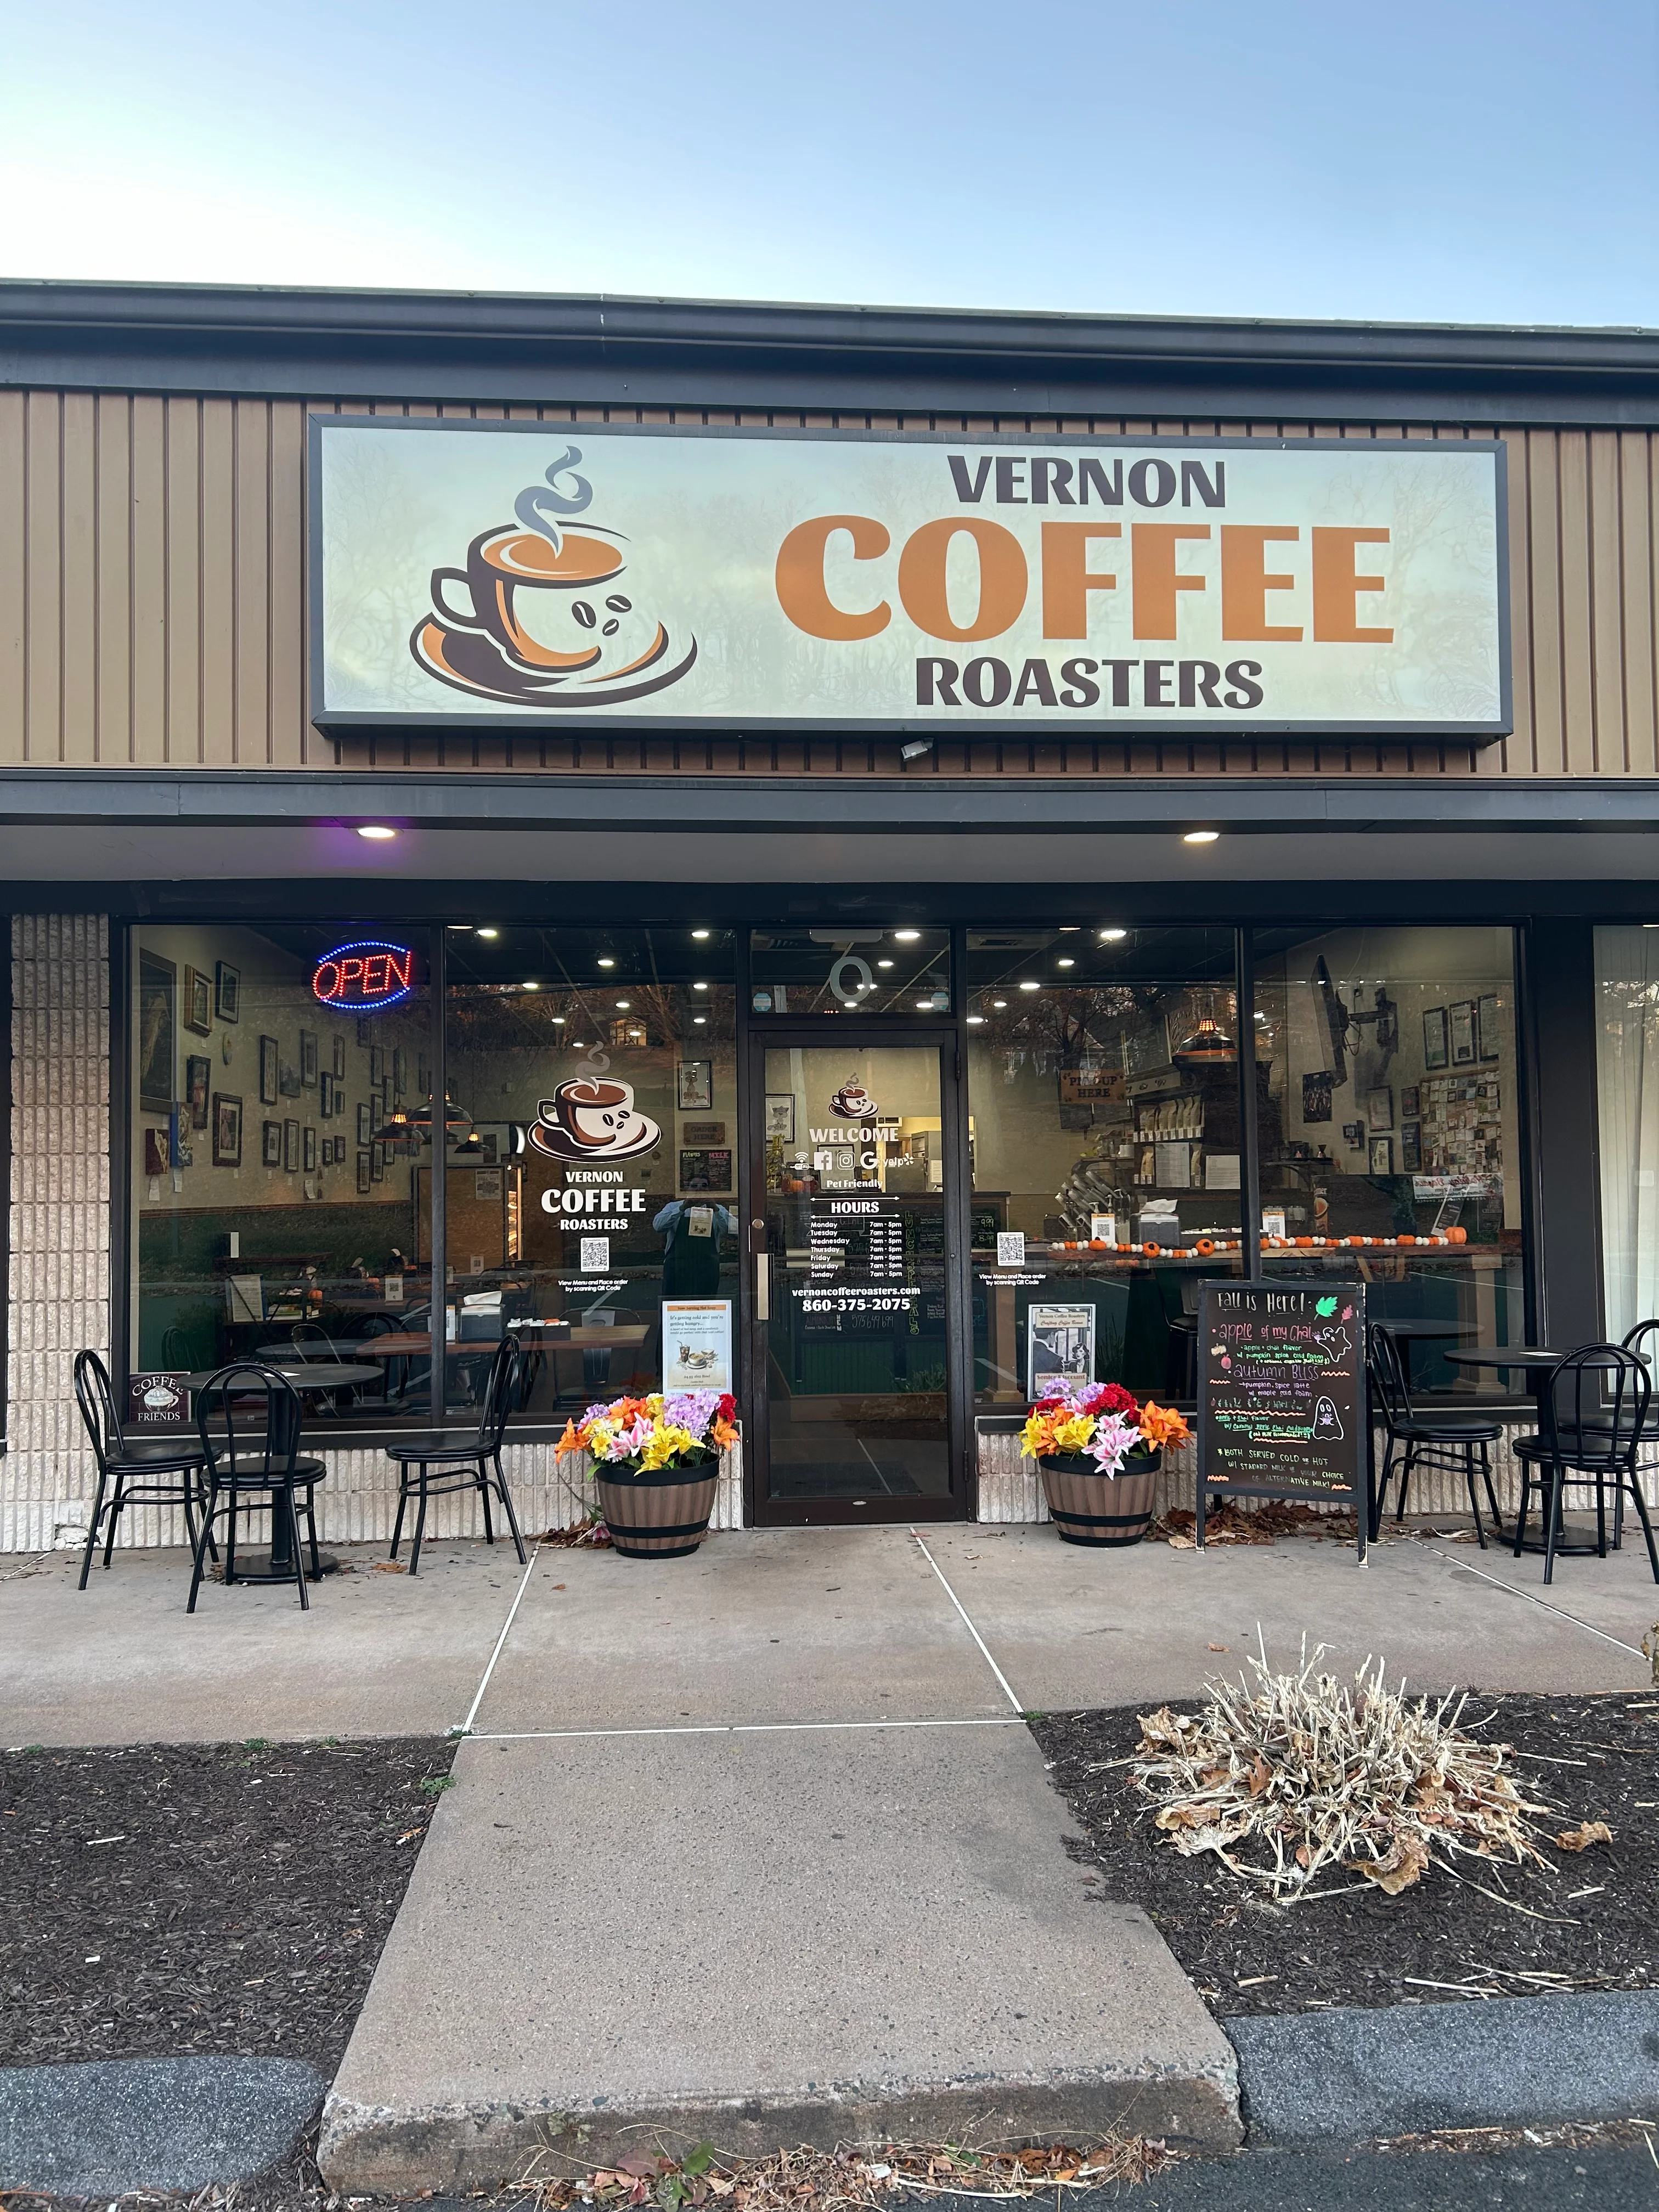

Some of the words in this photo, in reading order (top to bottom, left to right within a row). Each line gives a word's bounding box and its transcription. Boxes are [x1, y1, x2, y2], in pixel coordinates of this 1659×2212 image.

[947, 456, 1227, 508] VERNON
[775, 514, 1395, 644] COFFEE
[917, 657, 1263, 709] ROASTERS
[312, 951, 412, 1000] OPEN
[1077, 1088, 1110, 1097] HERE
[809, 1127, 899, 1142] WELCOME
[566, 1171, 624, 1183] VERNON
[826, 1180, 843, 1188] Pet
[844, 1179, 883, 1189] Friendly
[541, 1188, 646, 1214] COFFEE
[831, 1201, 880, 1214] HOURS
[560, 1218, 629, 1230] ROASTERS
[889, 1271, 902, 1279] 5pm
[792, 1286, 921, 1296] vernoncoffeeroasters.com
[802, 1298, 911, 1312] 860-375-2075
[1217, 1292, 1241, 1308] Fall
[1246, 1291, 1257, 1312] is
[1218, 1323, 1252, 1344] apple
[1261, 1324, 1269, 1341] of
[1273, 1326, 1287, 1340] my
[1290, 1325, 1312, 1341] Chai
[1246, 1351, 1271, 1359] pumpkin
[138, 1412, 180, 1421] FRIENDS
[1249, 1449, 1276, 1459] SERVED
[1279, 1454, 1300, 1463] COLD
[1312, 1457, 1329, 1466] HOT
[1265, 1474, 1309, 1486] ALTERNATIVE
[1312, 1479, 1330, 1488] MILK!
[1322, 1471, 1344, 1480] CHOICE
